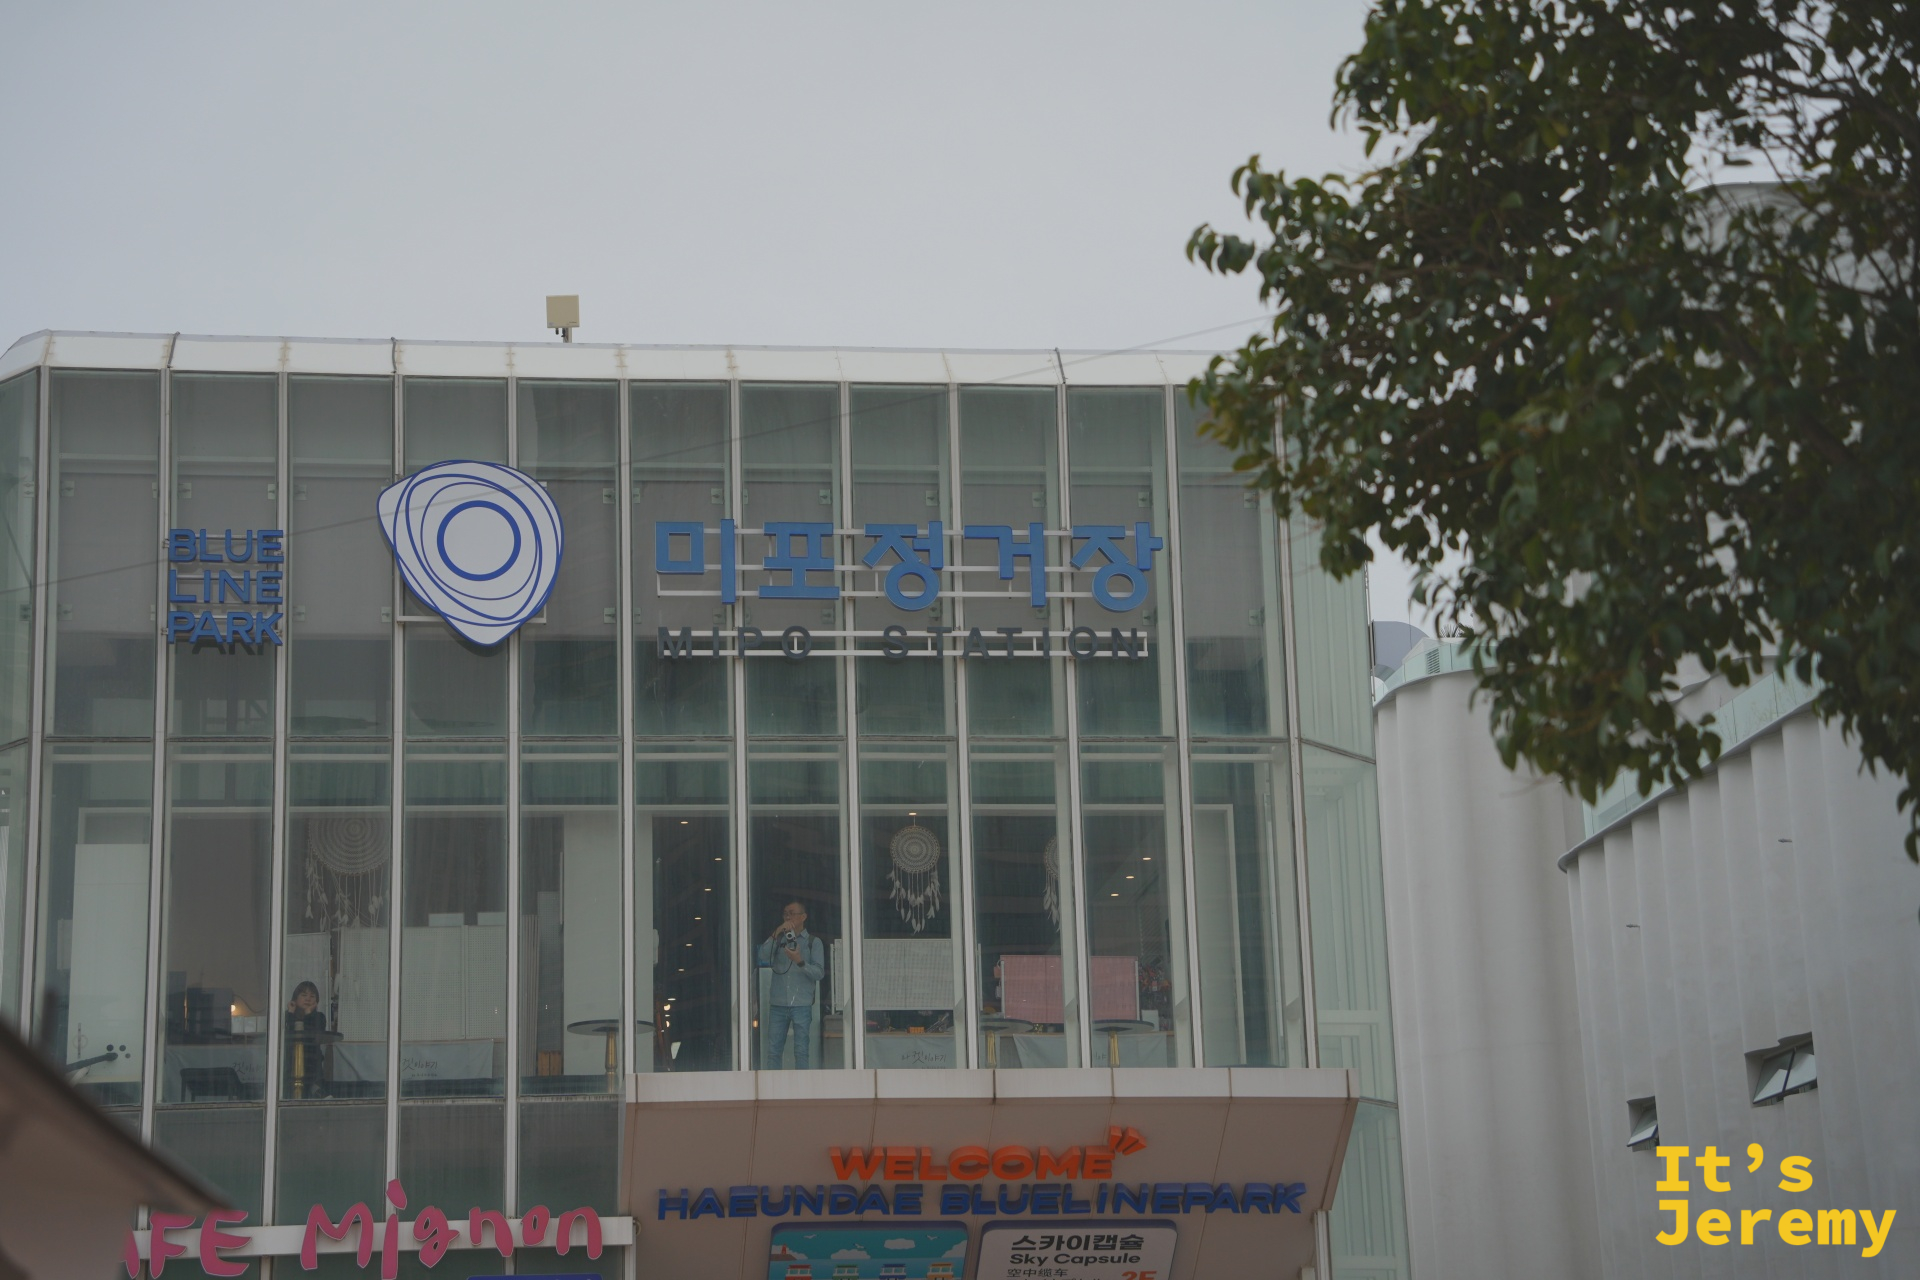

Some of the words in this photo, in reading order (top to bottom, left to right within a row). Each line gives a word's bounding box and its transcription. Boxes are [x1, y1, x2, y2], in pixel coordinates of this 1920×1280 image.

[168, 528, 284, 563] BLUE
[655, 518, 1163, 612] 미포정거장
[168, 569, 283, 604] LINE
[167, 611, 283, 646] PARK
[657, 625, 812, 659] MIPO
[883, 625, 1139, 660] STATION
[829, 1145, 1115, 1181] WELCOME
[656, 1183, 923, 1220] HAEUNDAE
[120, 1207, 252, 1279] FE
[300, 1178, 603, 1280] Mignon
[1011, 1233, 1145, 1251] 스카이캡슐
[1006, 1268, 1069, 1278] 空中缆车
[1009, 1253, 1048, 1266] Sky
[1054, 1252, 1141, 1266] Capsule
